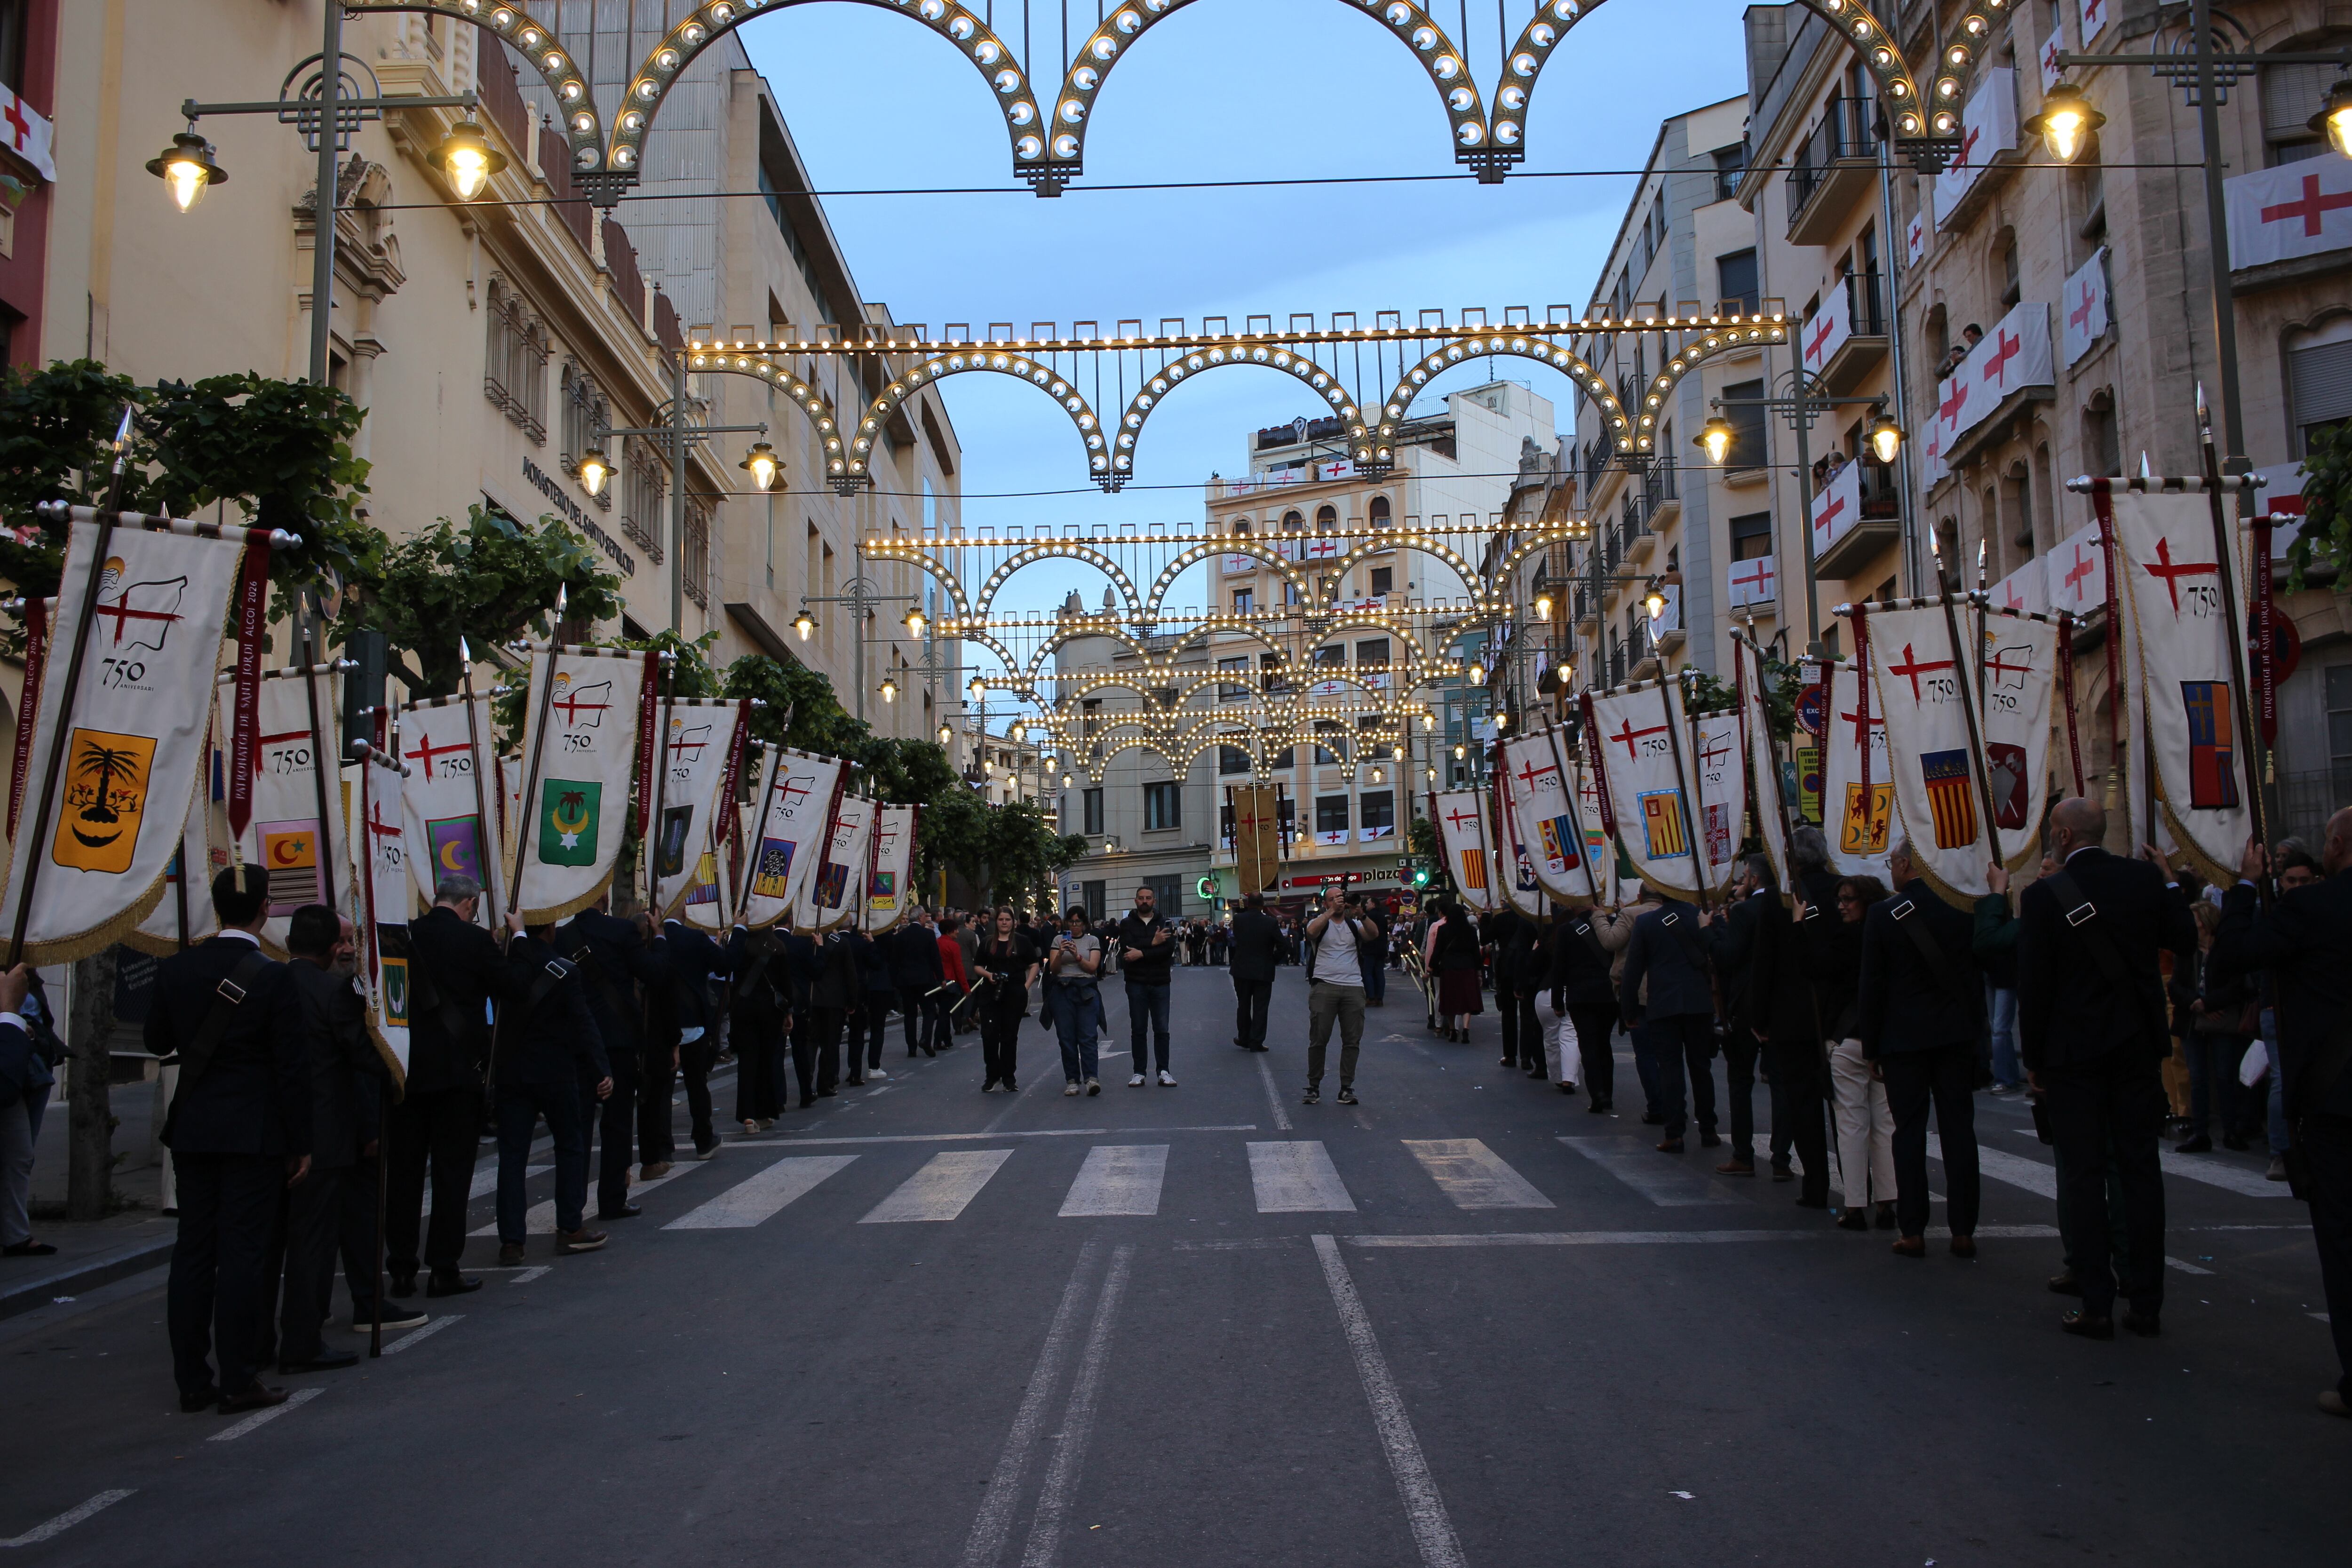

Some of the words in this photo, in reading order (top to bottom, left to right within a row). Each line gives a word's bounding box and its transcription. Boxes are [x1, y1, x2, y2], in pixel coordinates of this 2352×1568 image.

[523, 456, 569, 514] MONASTERIO
[570, 501, 583, 529] DEL
[583, 515, 605, 549] SANTO
[605, 535, 635, 577] SEPULCRO
[248, 581, 257, 603] 2026
[2188, 587, 2217, 619] 750
[2260, 601, 2269, 625] JORDI
[245, 608, 255, 637] ALCOI
[242, 644, 254, 676] JORDI
[2263, 654, 2270, 664] DE
[27, 659, 35, 686] ALCOY
[102, 658, 145, 690] 750
[241, 680, 252, 708] SANT
[1927, 679, 1954, 705] 750
[2263, 667, 2272, 719] PATRONATGE
[23, 692, 33, 719] JORGE
[1992, 693, 2016, 713] 750
[239, 714, 249, 727] DE
[1797, 709, 1814, 733] CARREGA
[21, 724, 31, 741] SAN
[1869, 732, 1886, 750] 75
[19, 746, 27, 756] DE
[563, 734, 591, 753] 750
[1642, 739, 1667, 757] 750
[235, 732, 248, 799] PATRONATGE
[272, 749, 310, 775] 750
[440, 758, 470, 779] 750
[643, 762, 649, 771] DE
[672, 768, 689, 783] 750
[1539, 776, 1557, 792] 750
[1706, 772, 1720, 787] 750
[775, 807, 793, 820] 750
[1584, 806, 1598, 816] 750
[1599, 788, 1611, 823] PATRONAZGO
[1464, 822, 1478, 831] 750
[833, 838, 846, 849] 750
[879, 848, 890, 857] 50
[384, 846, 400, 873] 50
